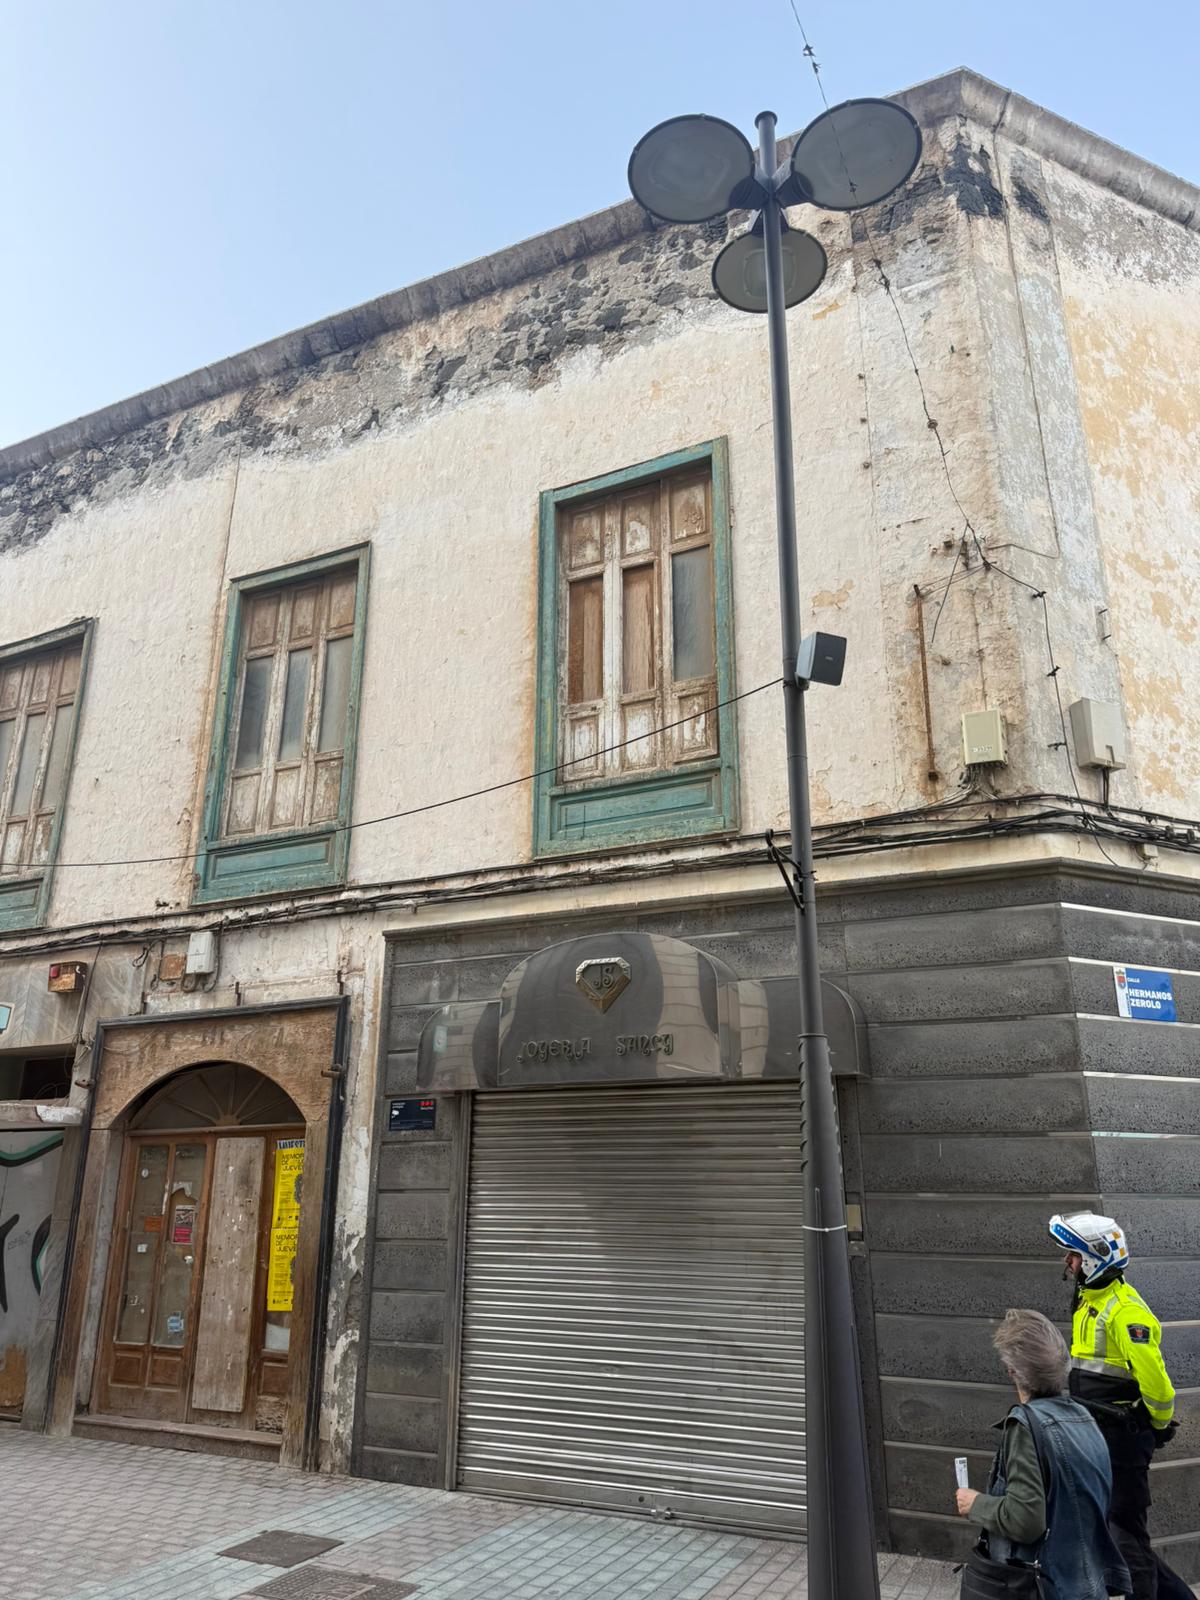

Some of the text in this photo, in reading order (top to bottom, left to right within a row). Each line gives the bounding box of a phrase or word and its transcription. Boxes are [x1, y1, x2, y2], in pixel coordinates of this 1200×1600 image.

[592, 965, 615, 989] JS
[1129, 988, 1172, 1000] HERMANOS
[1130, 998, 1161, 1009] ZEROLO
[616, 1033, 674, 1056] SANCY
